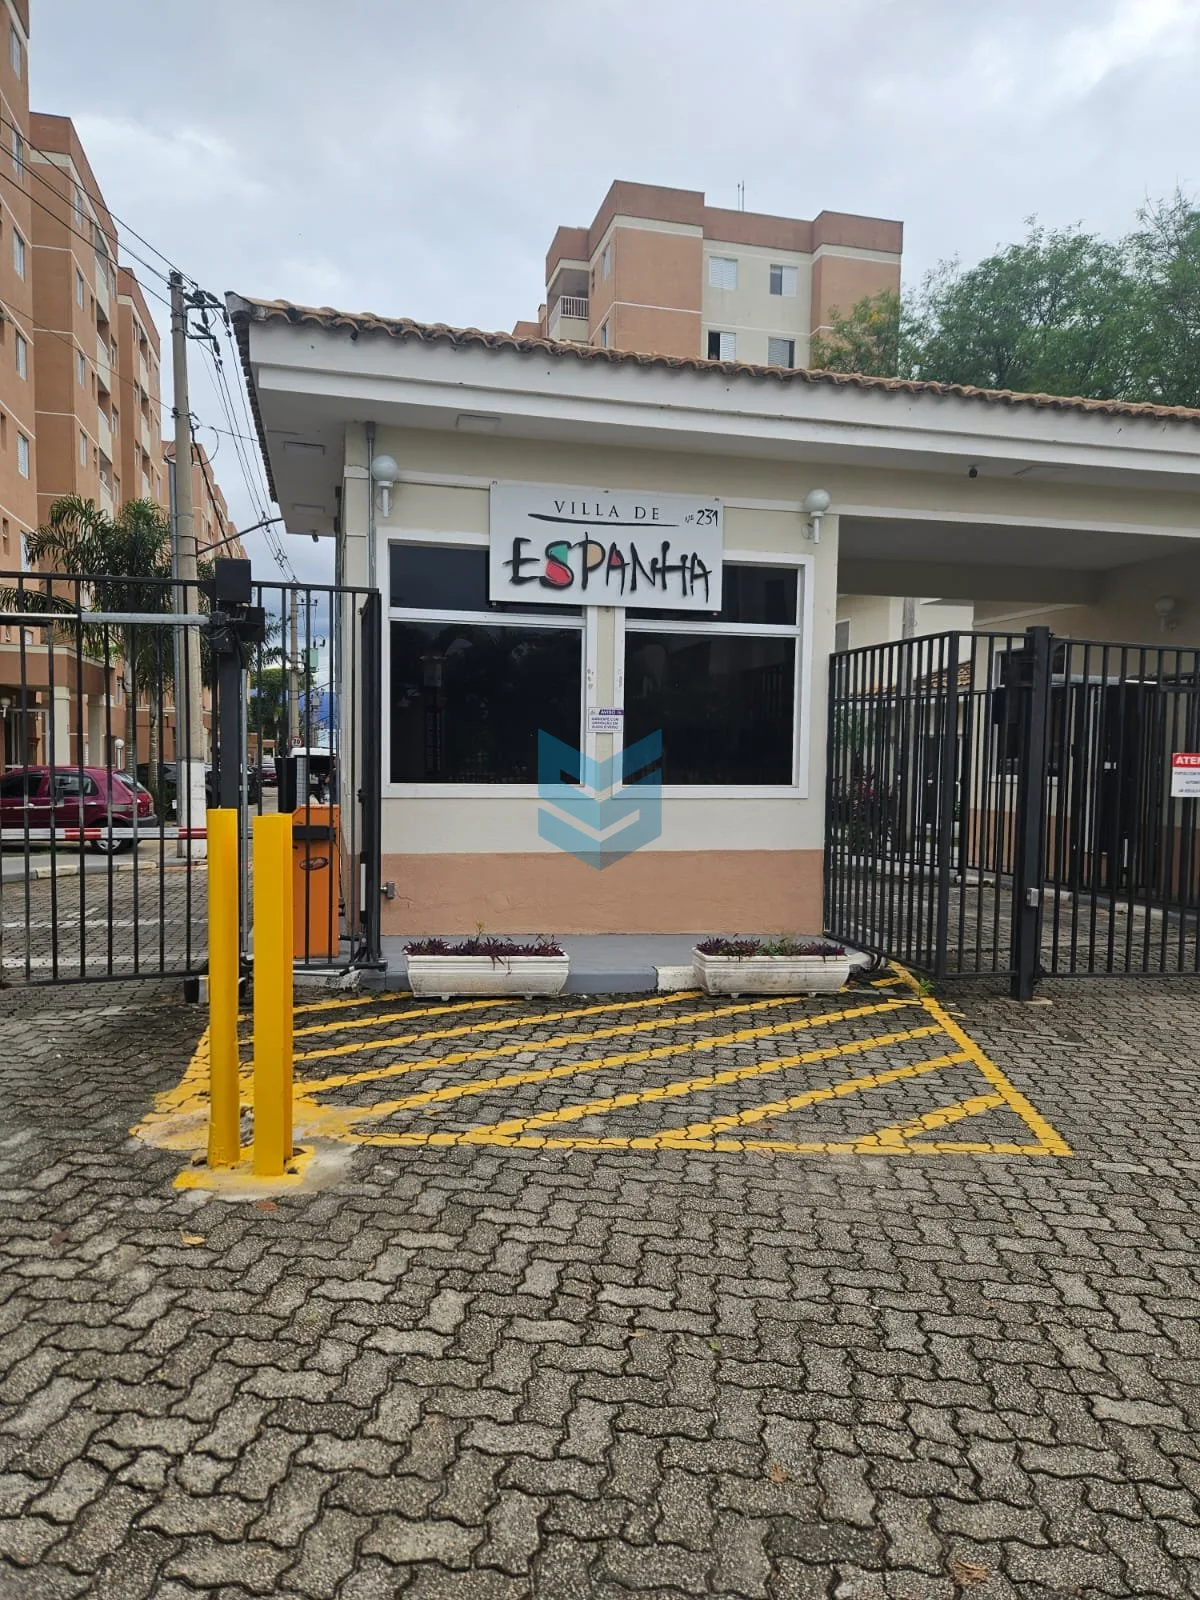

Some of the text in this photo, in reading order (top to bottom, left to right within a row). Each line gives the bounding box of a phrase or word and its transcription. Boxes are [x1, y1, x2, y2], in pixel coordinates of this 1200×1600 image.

[554, 500, 660, 520] VILLA DE
[696, 508, 719, 526] 231
[502, 531, 713, 604] ESPANHA
